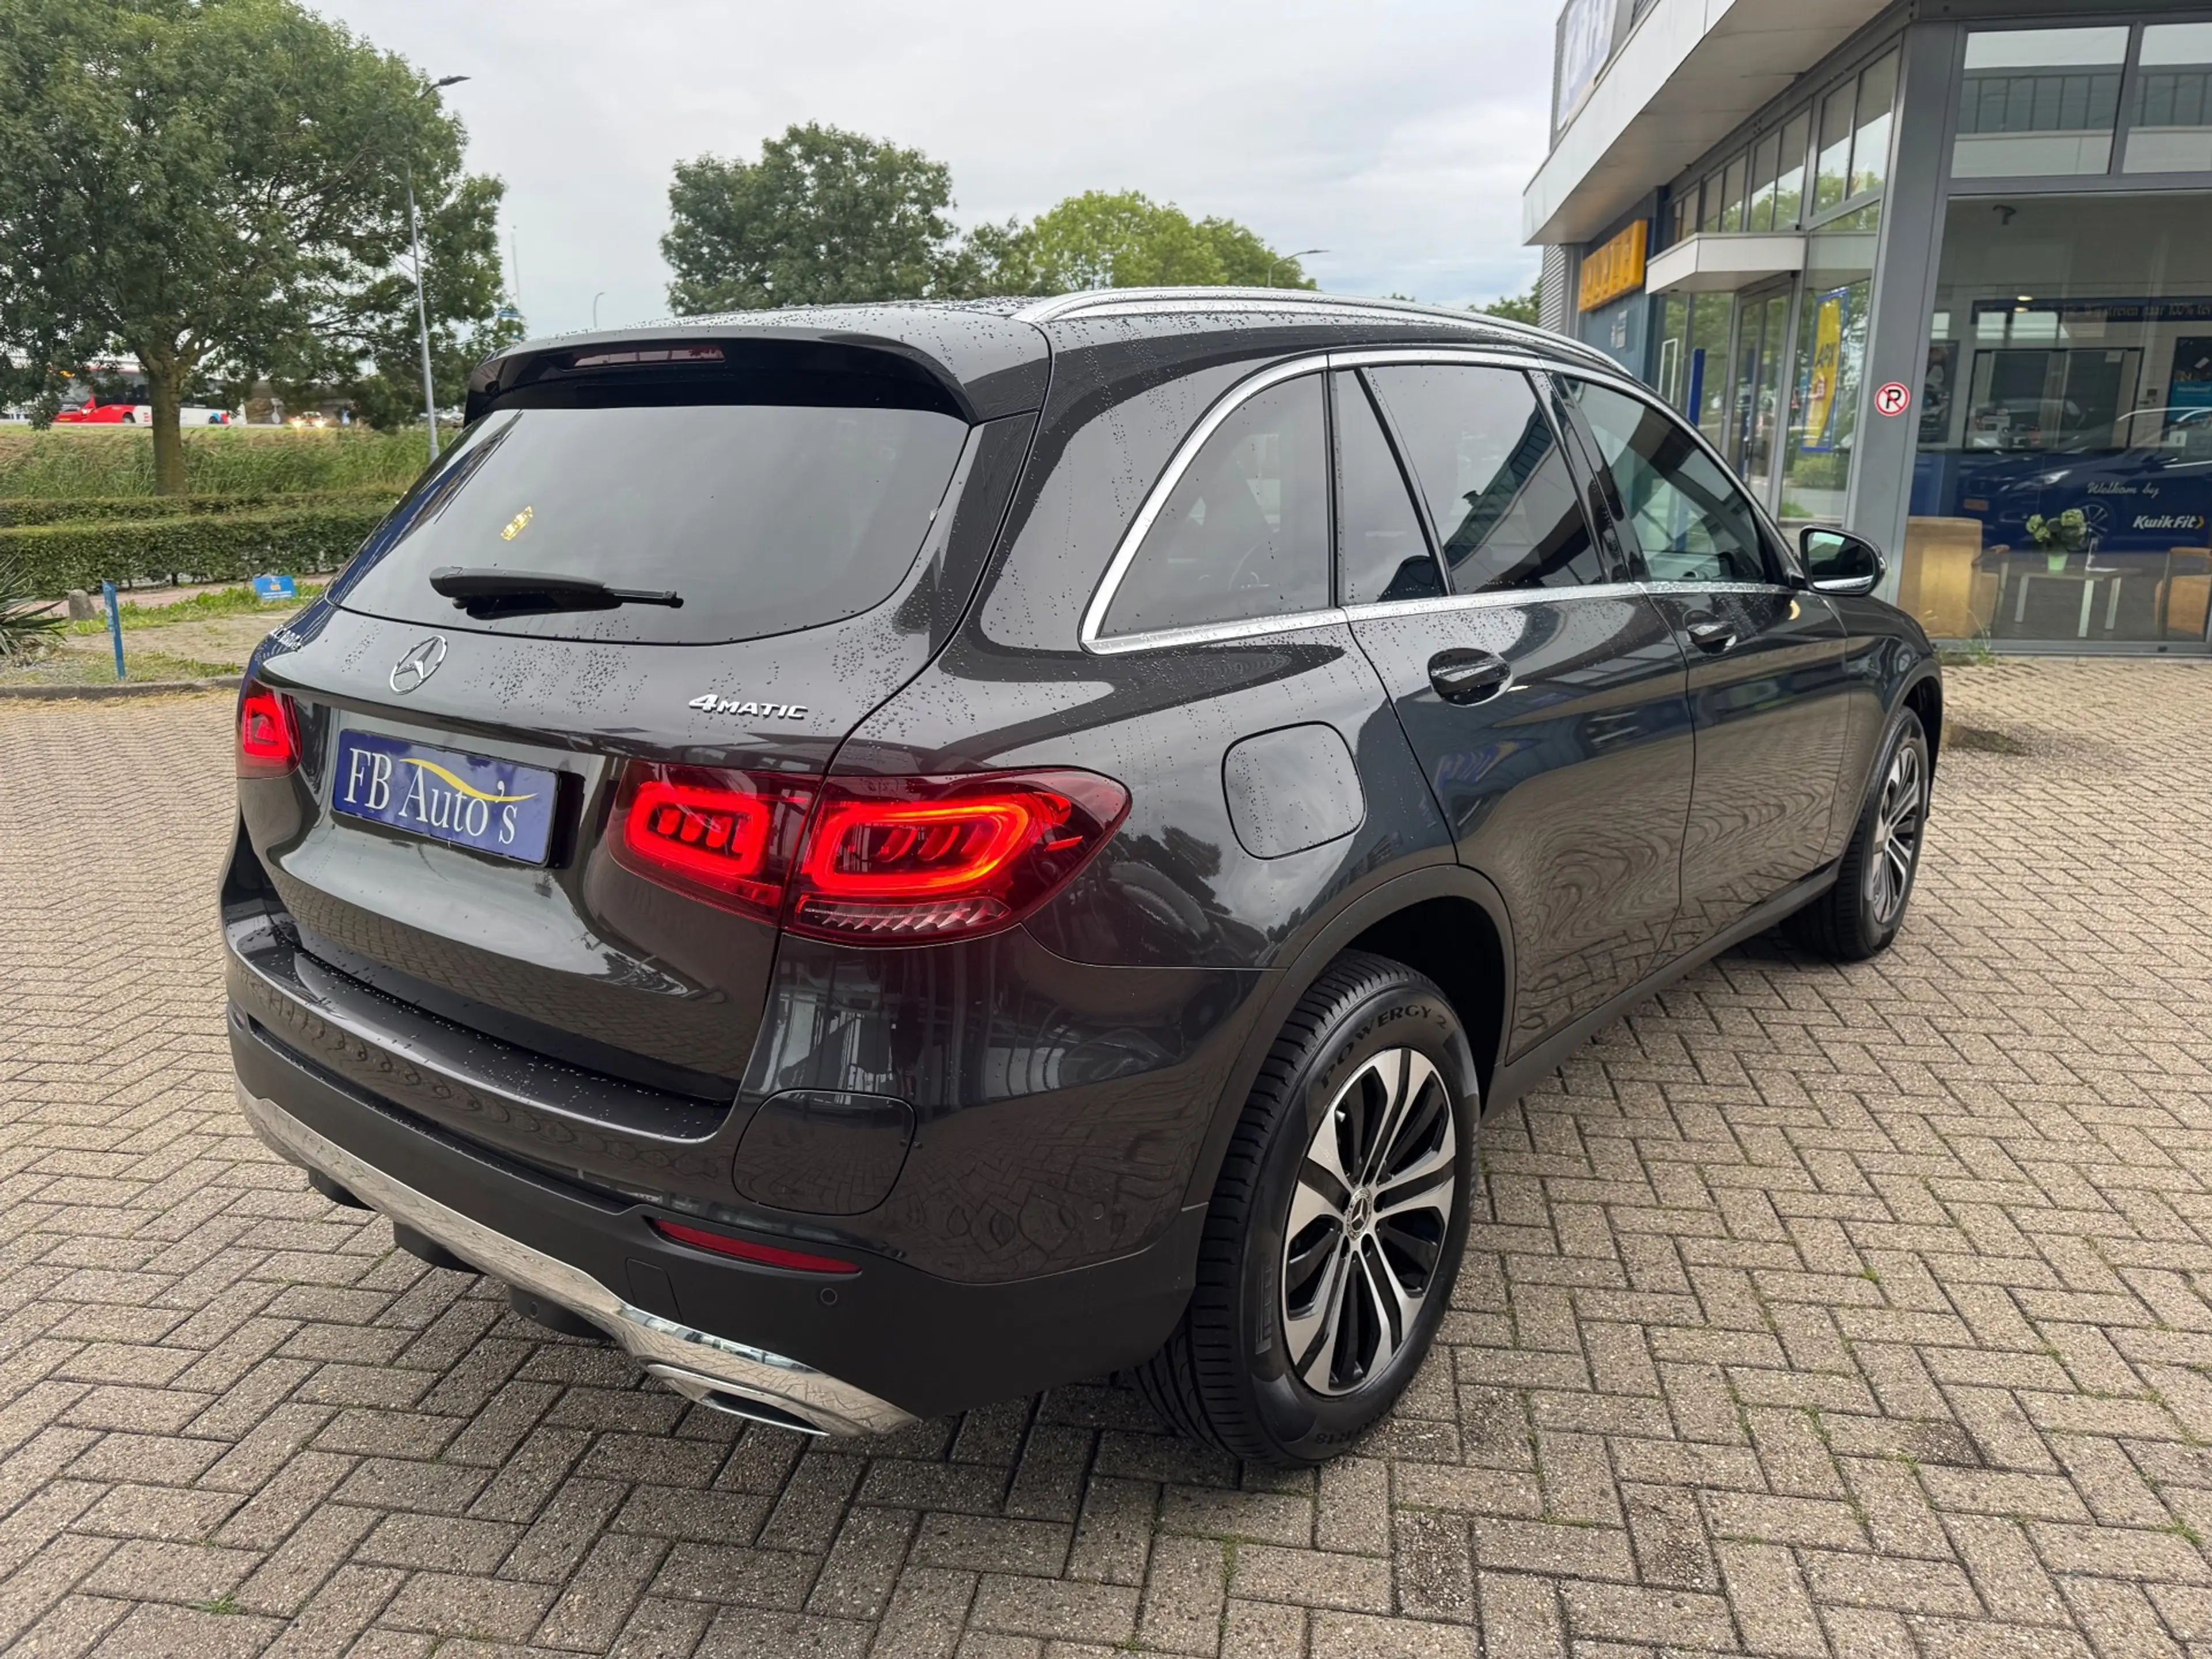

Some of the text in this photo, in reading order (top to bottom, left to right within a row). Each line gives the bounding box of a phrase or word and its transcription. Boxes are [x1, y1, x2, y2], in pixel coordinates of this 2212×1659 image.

[688, 694, 808, 720] 4MATIC
[343, 748, 517, 844] FB Auto's
[1321, 1005, 1432, 1089] POWERGY
